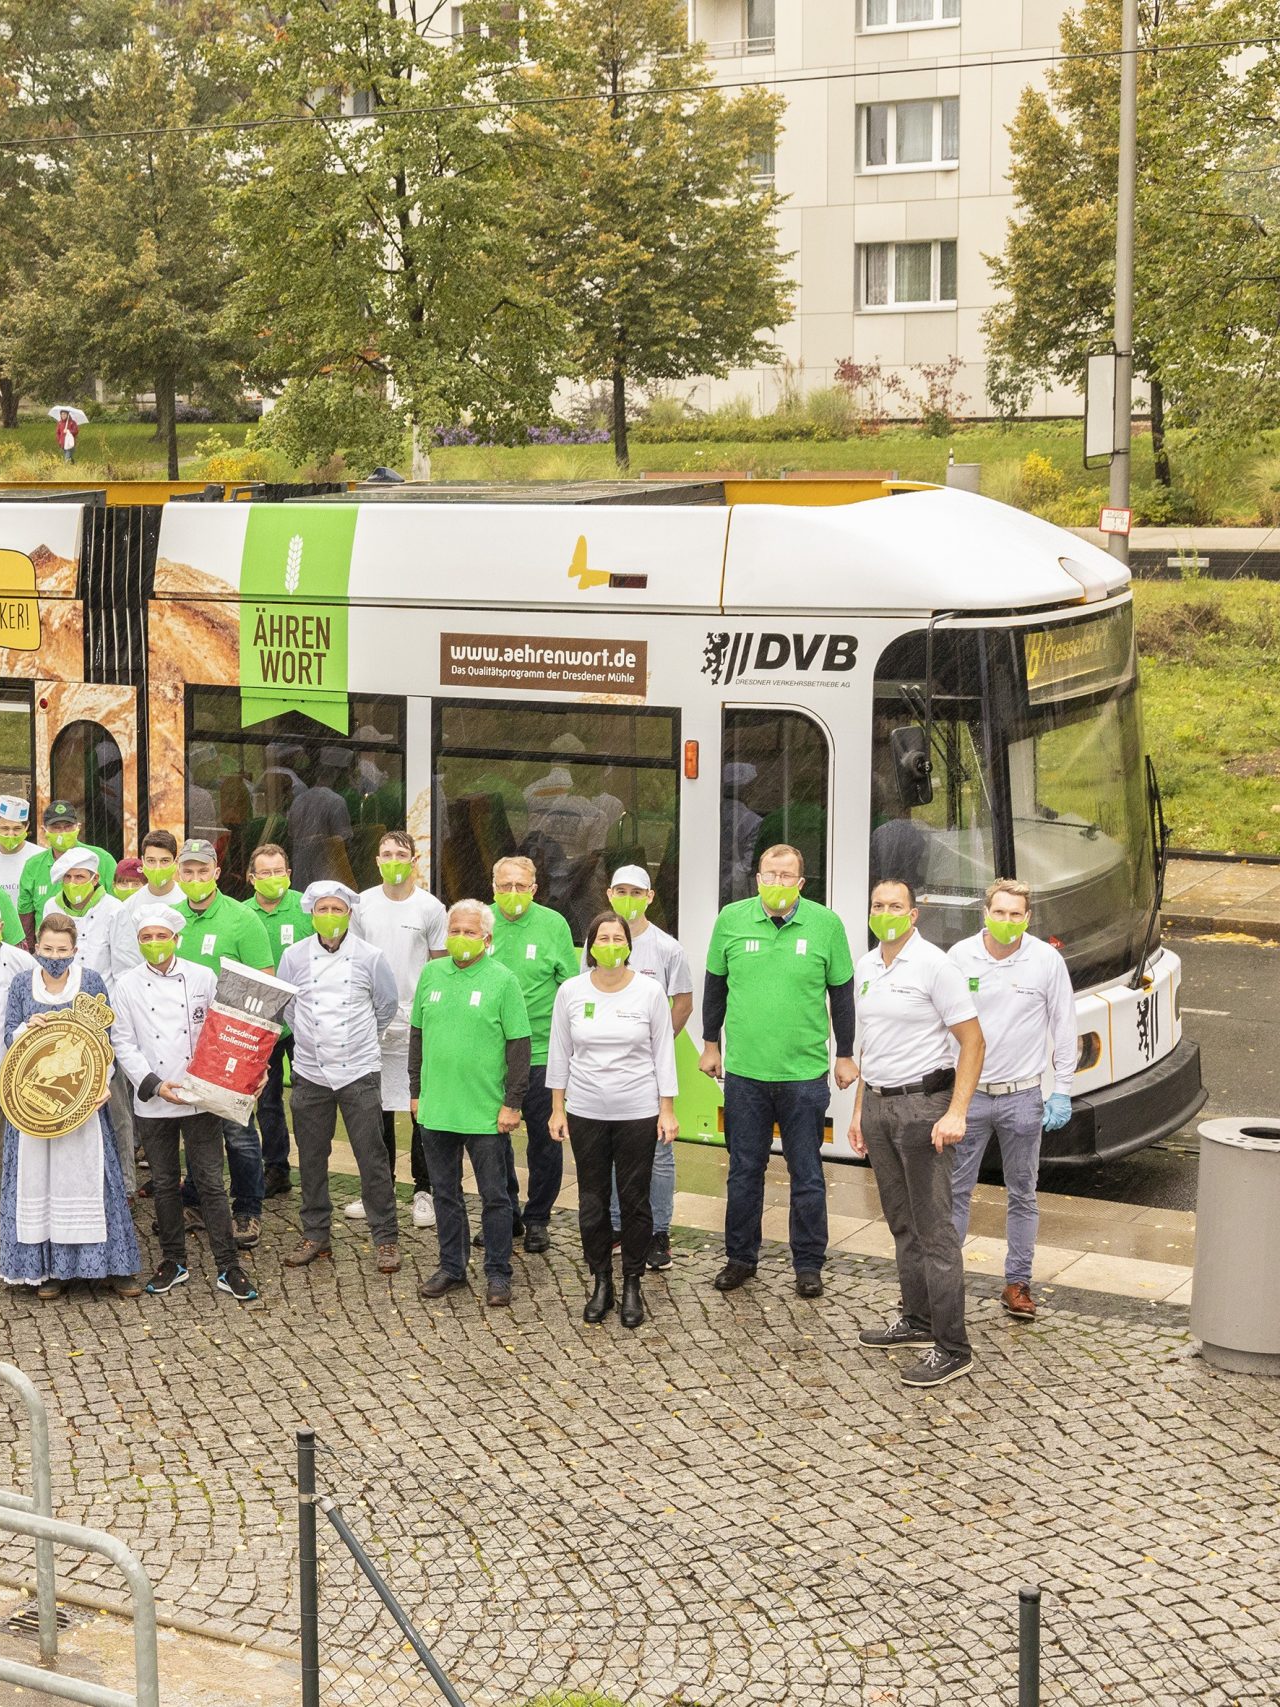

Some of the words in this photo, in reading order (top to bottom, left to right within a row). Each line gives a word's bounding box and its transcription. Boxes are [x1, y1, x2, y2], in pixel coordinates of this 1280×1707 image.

[253, 608, 330, 650] ÄHREN
[450, 644, 636, 668] www.aehrenwort.de
[754, 632, 859, 672] DVB
[260, 650, 326, 686] WORT
[452, 665, 466, 675] Das
[468, 666, 545, 680] Qualitätsprogramm
[546, 670, 560, 680] der
[562, 670, 605, 682] Dresdener
[608, 672, 635, 684] Mühle
[773, 680, 839, 688] VERKEHRSBETRIEBE
[218, 1032, 260, 1052] Stollenmehl
[225, 1024, 260, 1042] Dresdener
